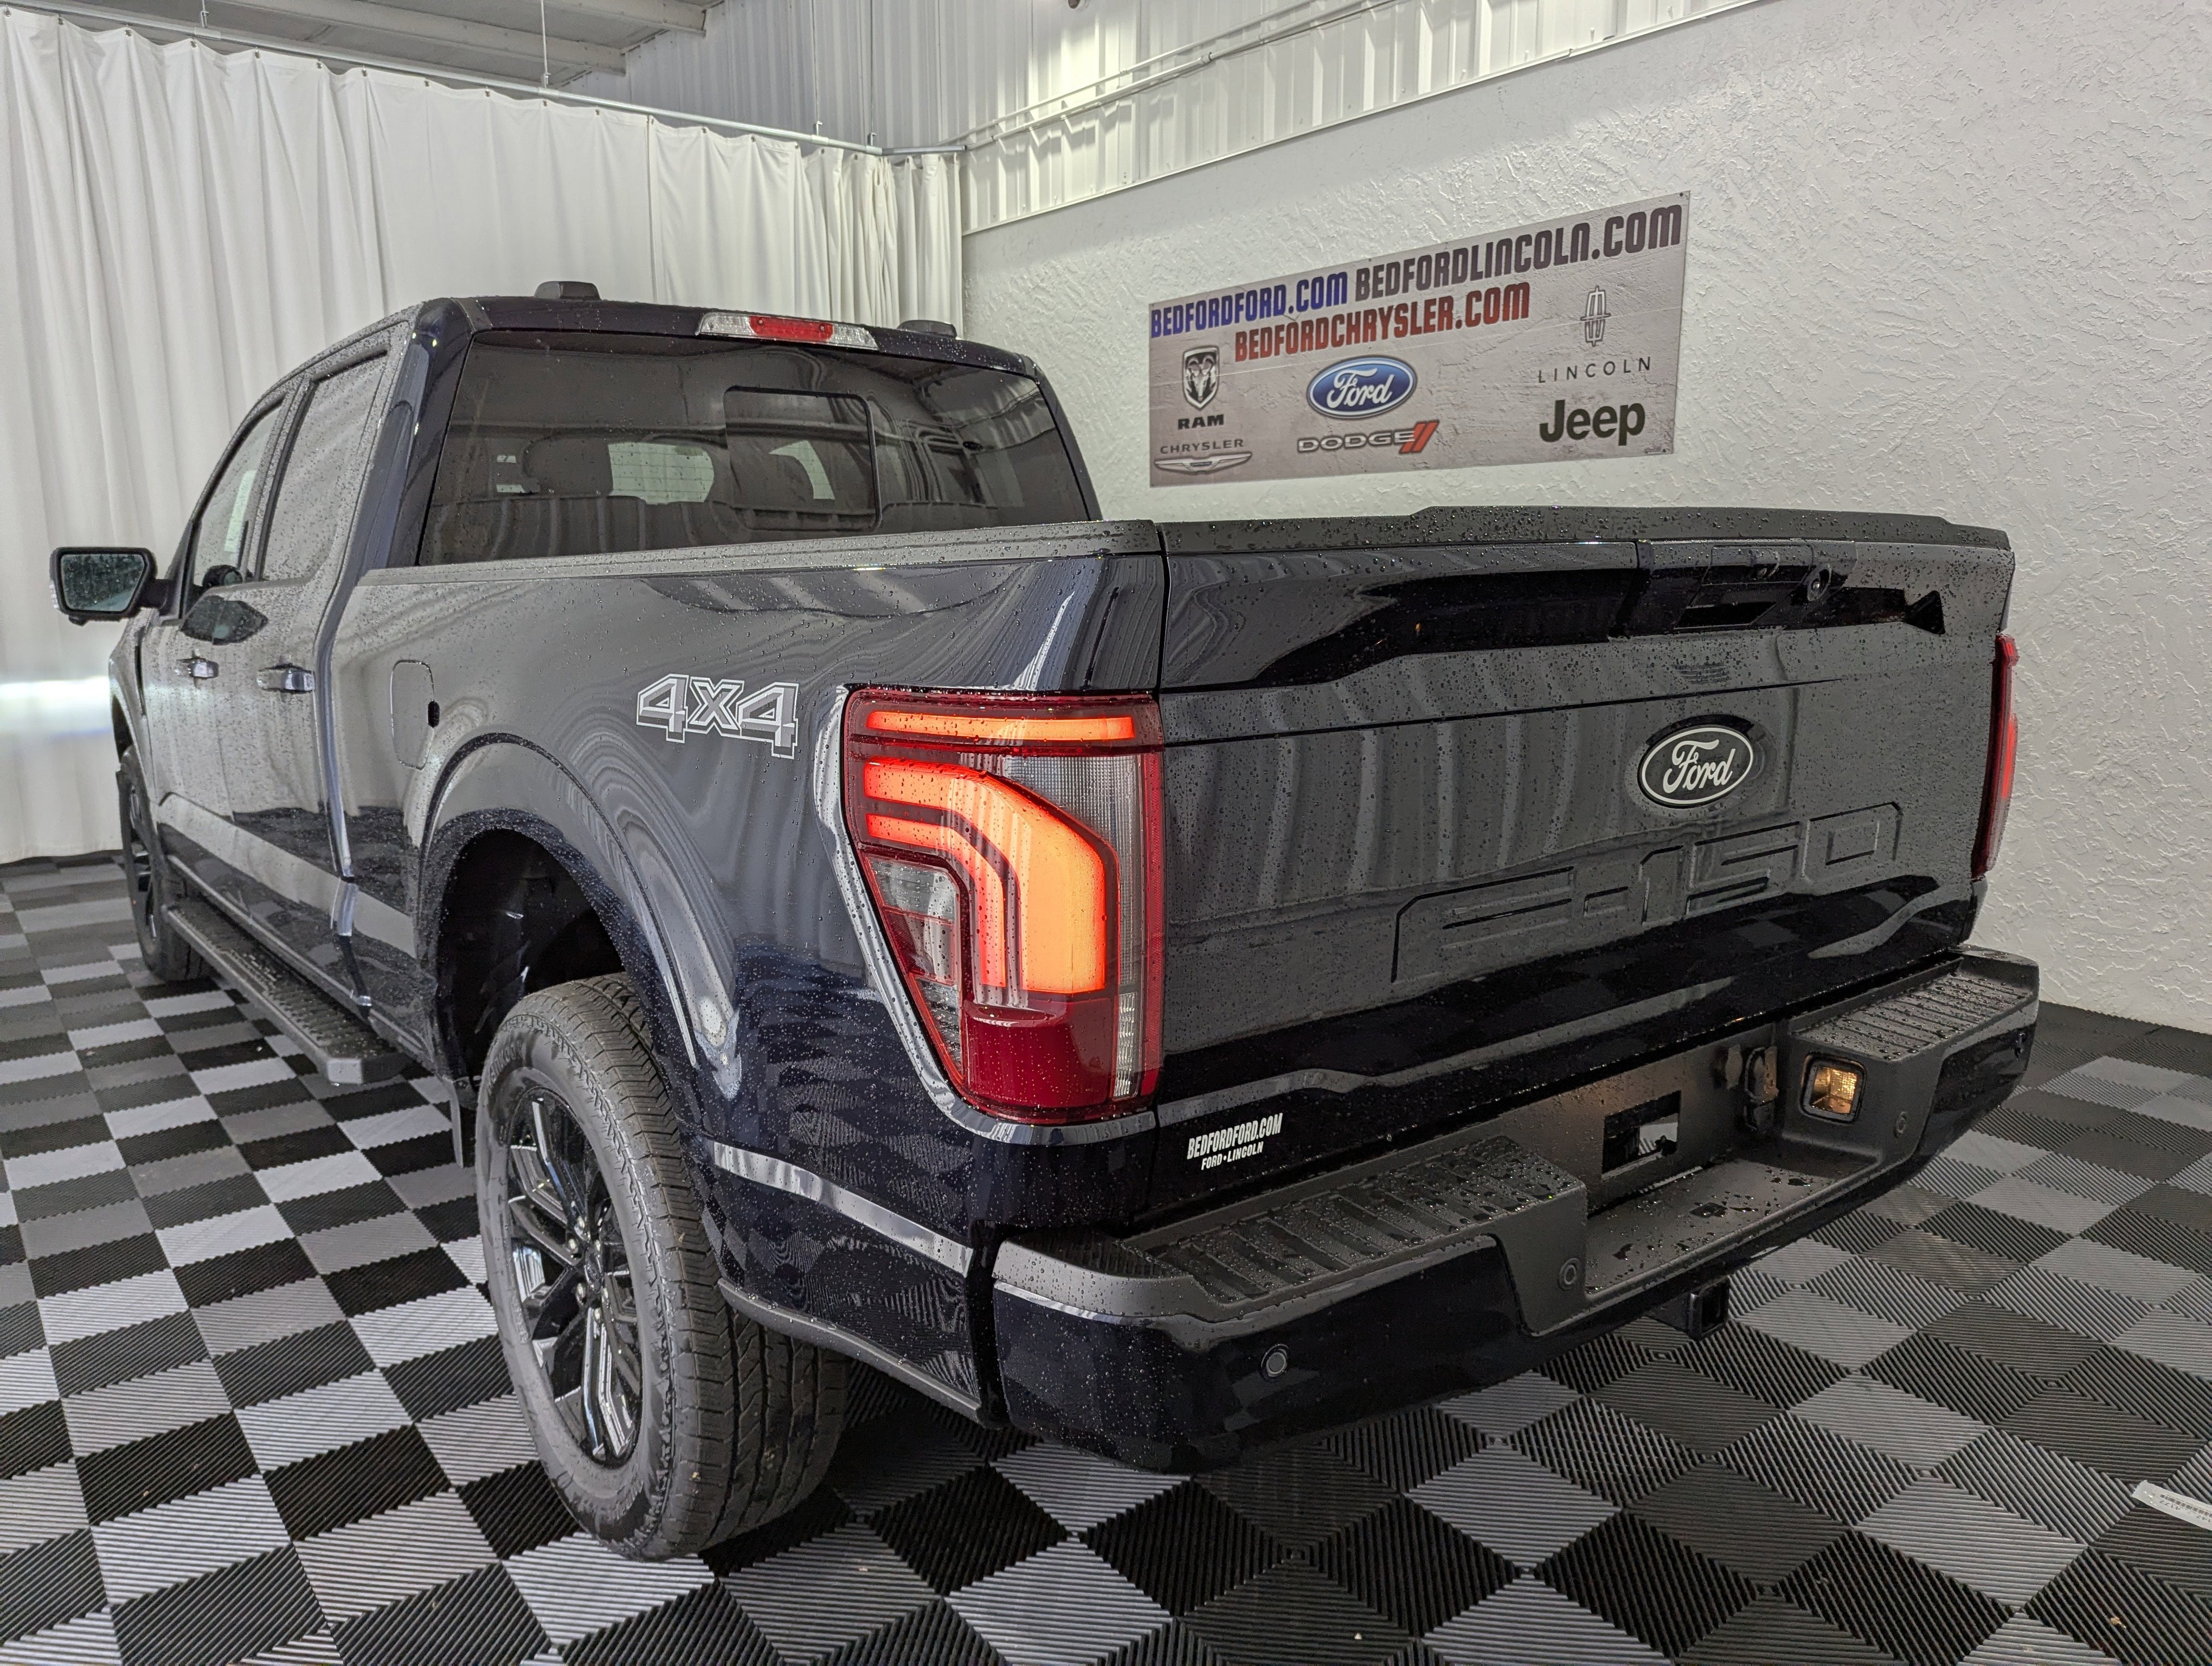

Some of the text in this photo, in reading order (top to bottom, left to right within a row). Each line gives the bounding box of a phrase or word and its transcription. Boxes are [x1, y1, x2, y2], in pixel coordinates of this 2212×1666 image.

[1150, 204, 1682, 338] BEDFORDFORD.COM BEDFORDLINCOLN.COM
[1234, 281, 1531, 362] BEDFORDCHRYSLER.COM
[1326, 367, 1395, 409] Ford
[1538, 356, 1651, 383] LINCOLN
[1177, 413, 1225, 430] RAM
[1297, 427, 1416, 453] DODGE
[1539, 399, 1646, 447] Jeep
[1160, 438, 1244, 454] CHRYSLER
[1662, 739, 1737, 793] Ford
[1186, 1112, 1283, 1160] BEDFORDFORD.COM
[1200, 1140, 1264, 1171] FORD LINCOLN
